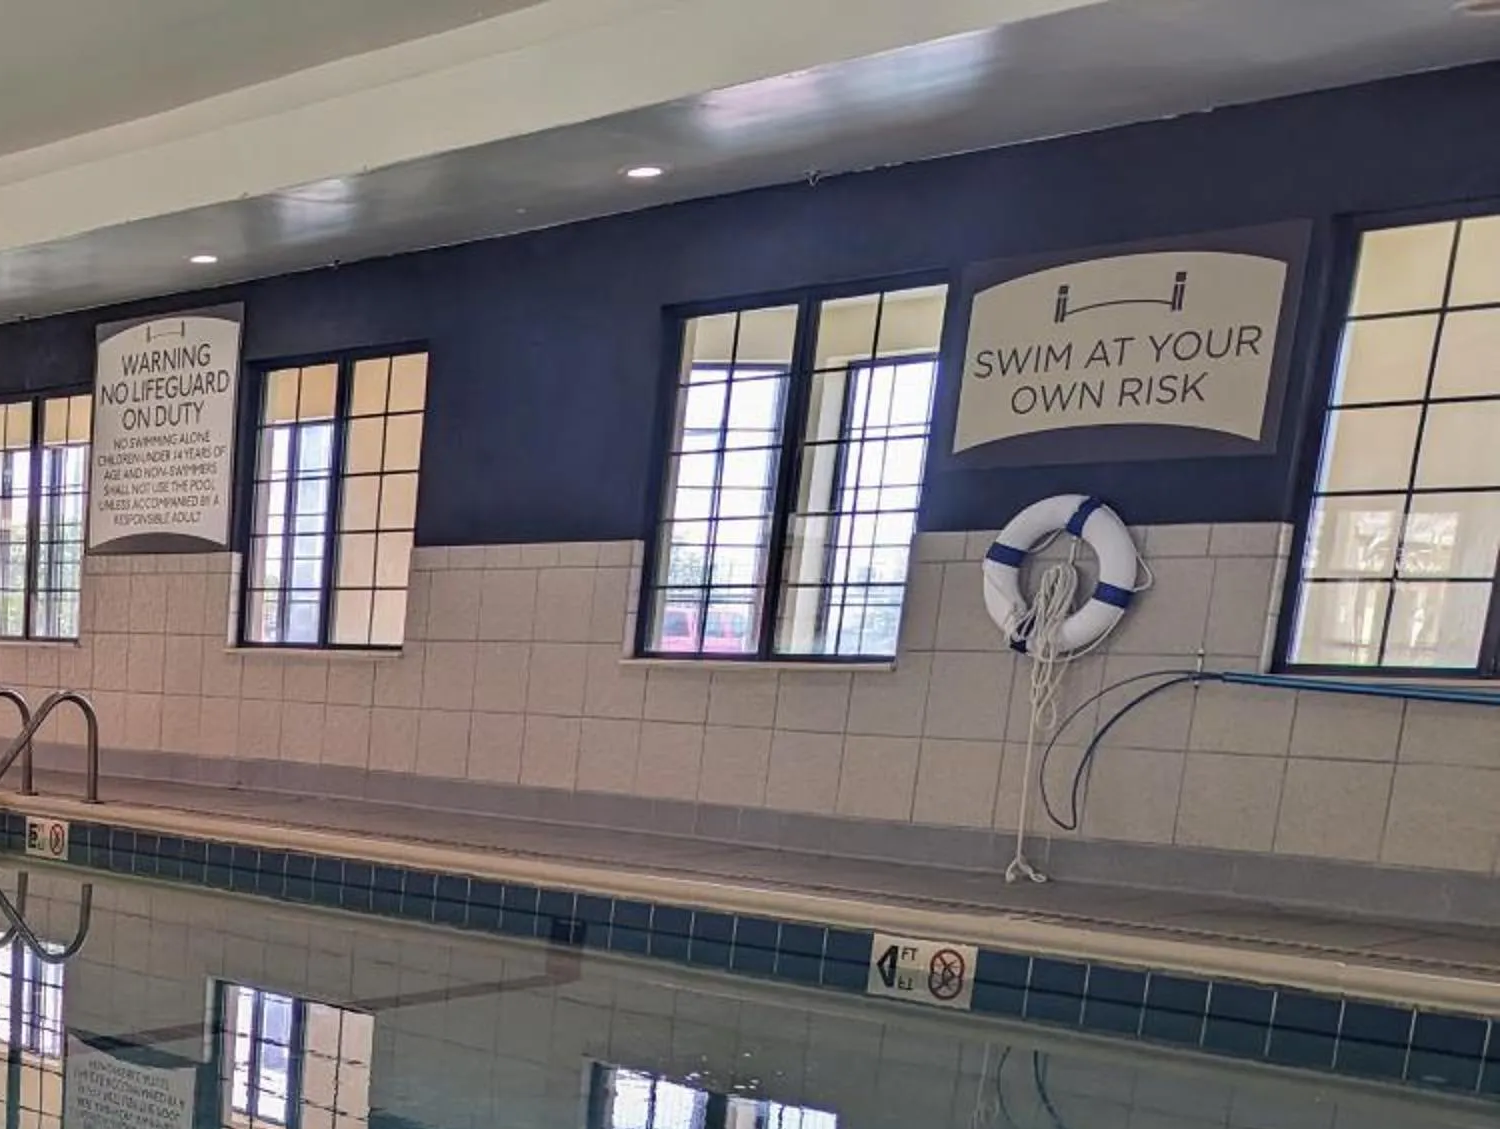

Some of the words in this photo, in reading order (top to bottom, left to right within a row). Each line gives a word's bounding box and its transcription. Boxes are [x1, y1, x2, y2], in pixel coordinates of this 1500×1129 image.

[121, 343, 211, 376] WARNING
[973, 342, 1073, 379] SWIM
[1084, 337, 1137, 369] AT
[1149, 325, 1263, 363] YOUR
[101, 382, 129, 406] NO
[133, 370, 230, 403] LIFEGUARD
[1011, 379, 1105, 415] OWN
[1118, 372, 1209, 408] RISK
[122, 407, 149, 430] ON
[155, 401, 204, 427] DUTY
[114, 440, 128, 450] NO
[901, 947, 918, 960] FT
